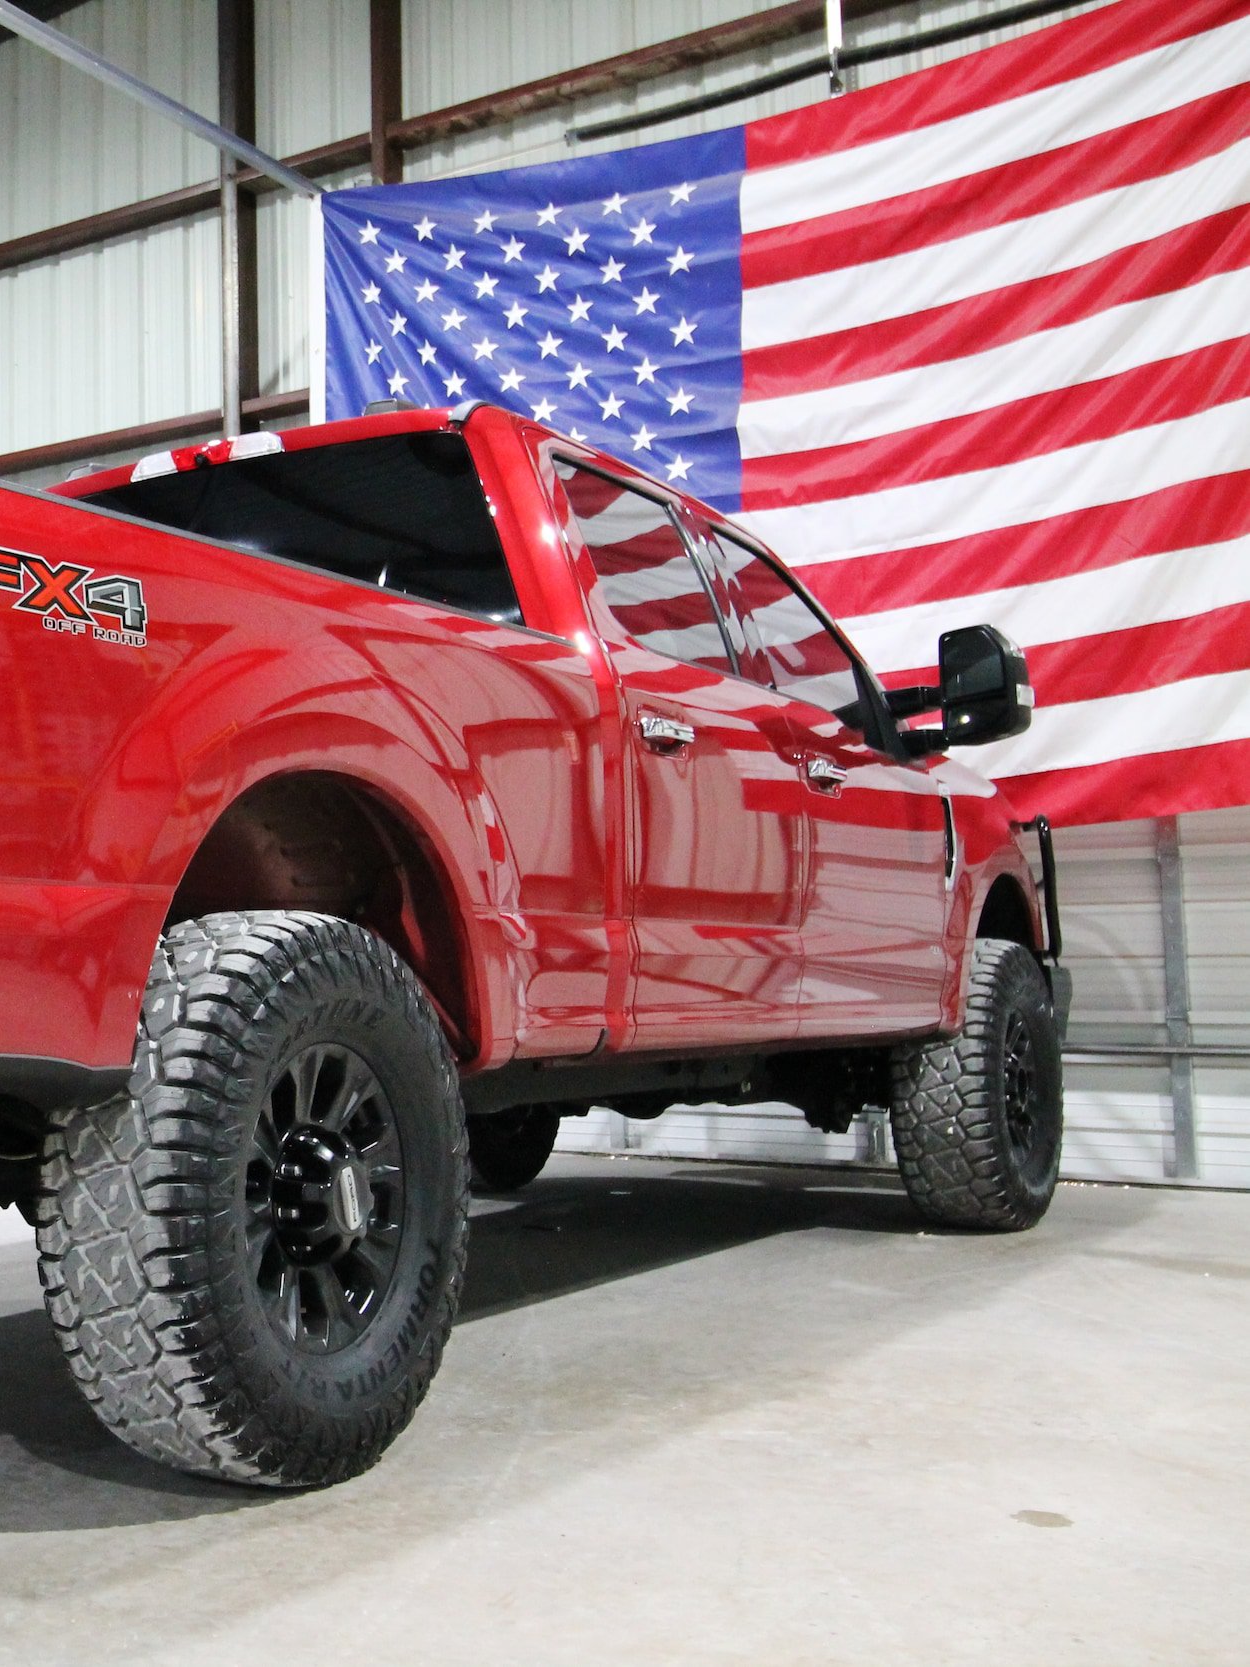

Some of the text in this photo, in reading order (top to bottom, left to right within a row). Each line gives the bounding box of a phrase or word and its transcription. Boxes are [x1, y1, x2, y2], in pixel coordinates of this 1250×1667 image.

[43, 617, 147, 648] OFF ROAD
[334, 1238, 442, 1399] TORMENTA
